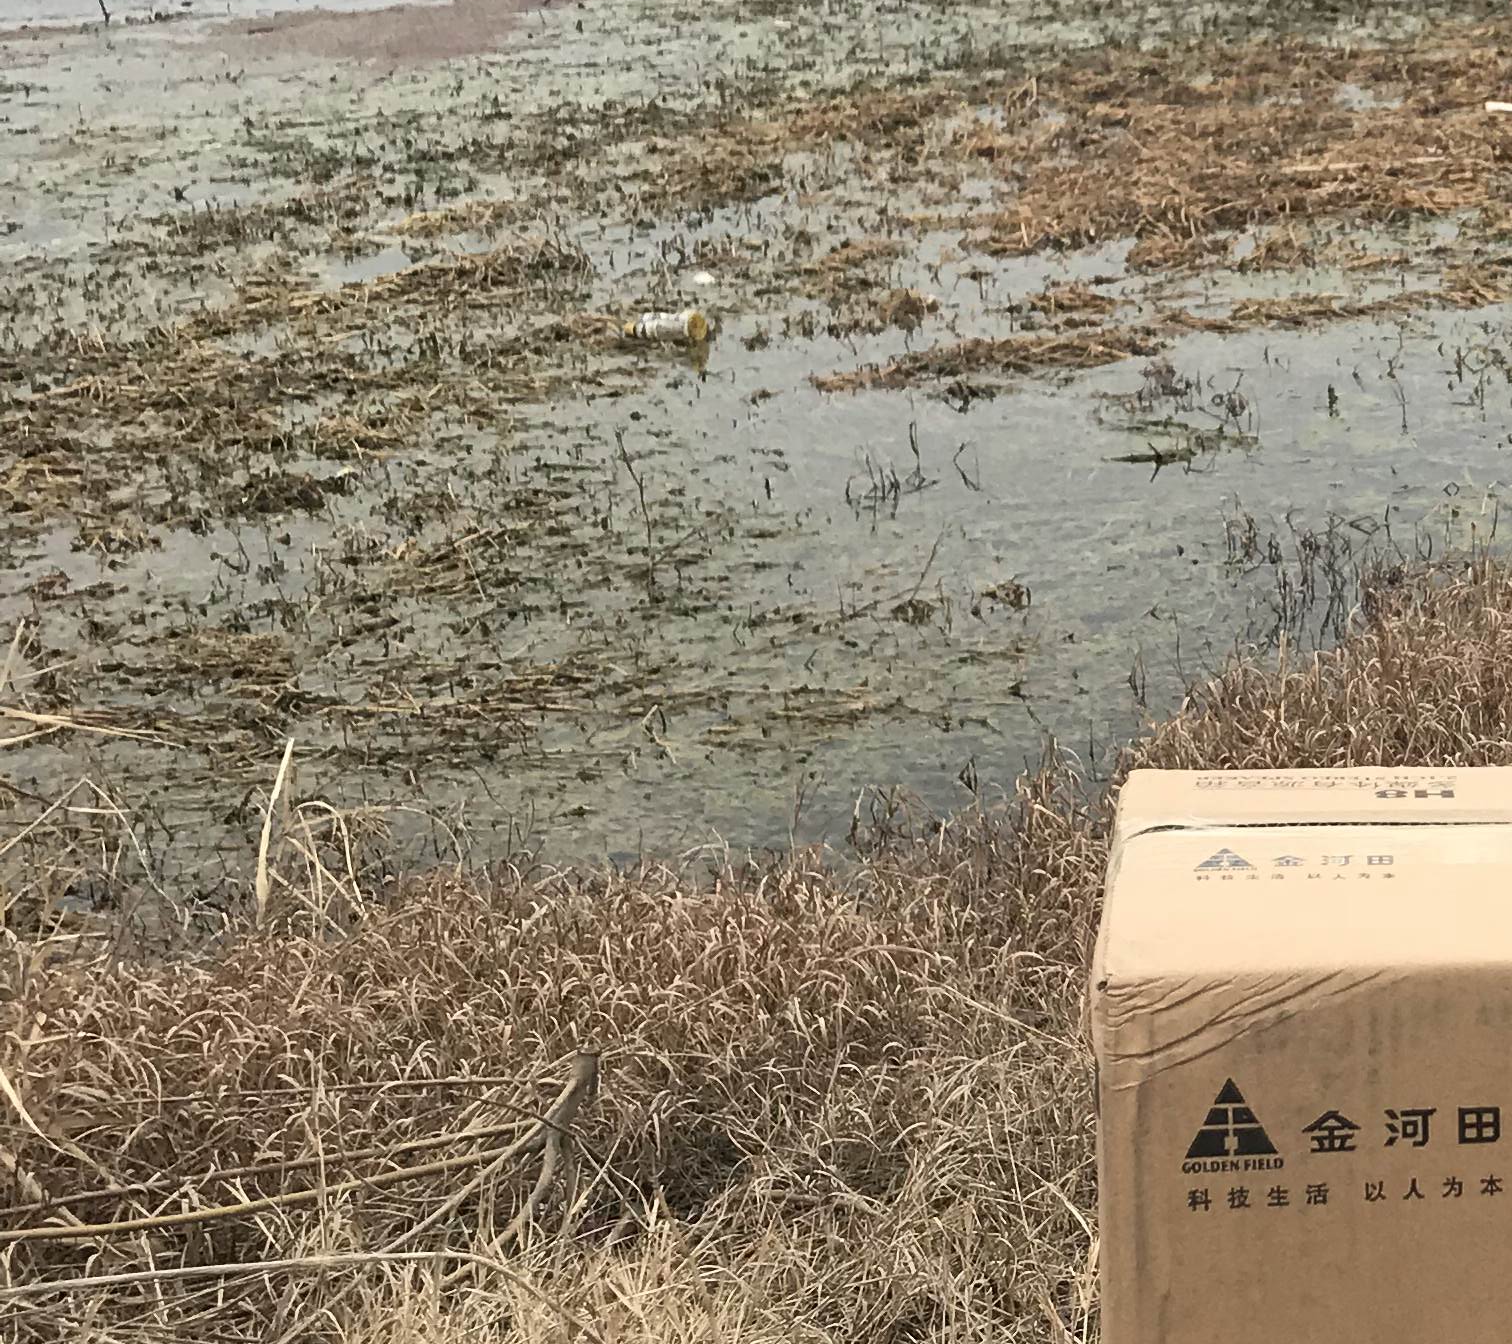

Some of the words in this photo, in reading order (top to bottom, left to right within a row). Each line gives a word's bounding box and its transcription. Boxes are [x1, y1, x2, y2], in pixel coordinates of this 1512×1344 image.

[1374, 789, 1455, 798] H8
[1271, 854, 1395, 867] 金河田
[1300, 1106, 1501, 1154] 金河田
[1181, 1159, 1241, 1175] GOLDEN
[1243, 1157, 1285, 1172] FIELD
[1186, 1181, 1331, 1212] 科技生活
[1363, 1173, 1504, 1203] 以人为本
